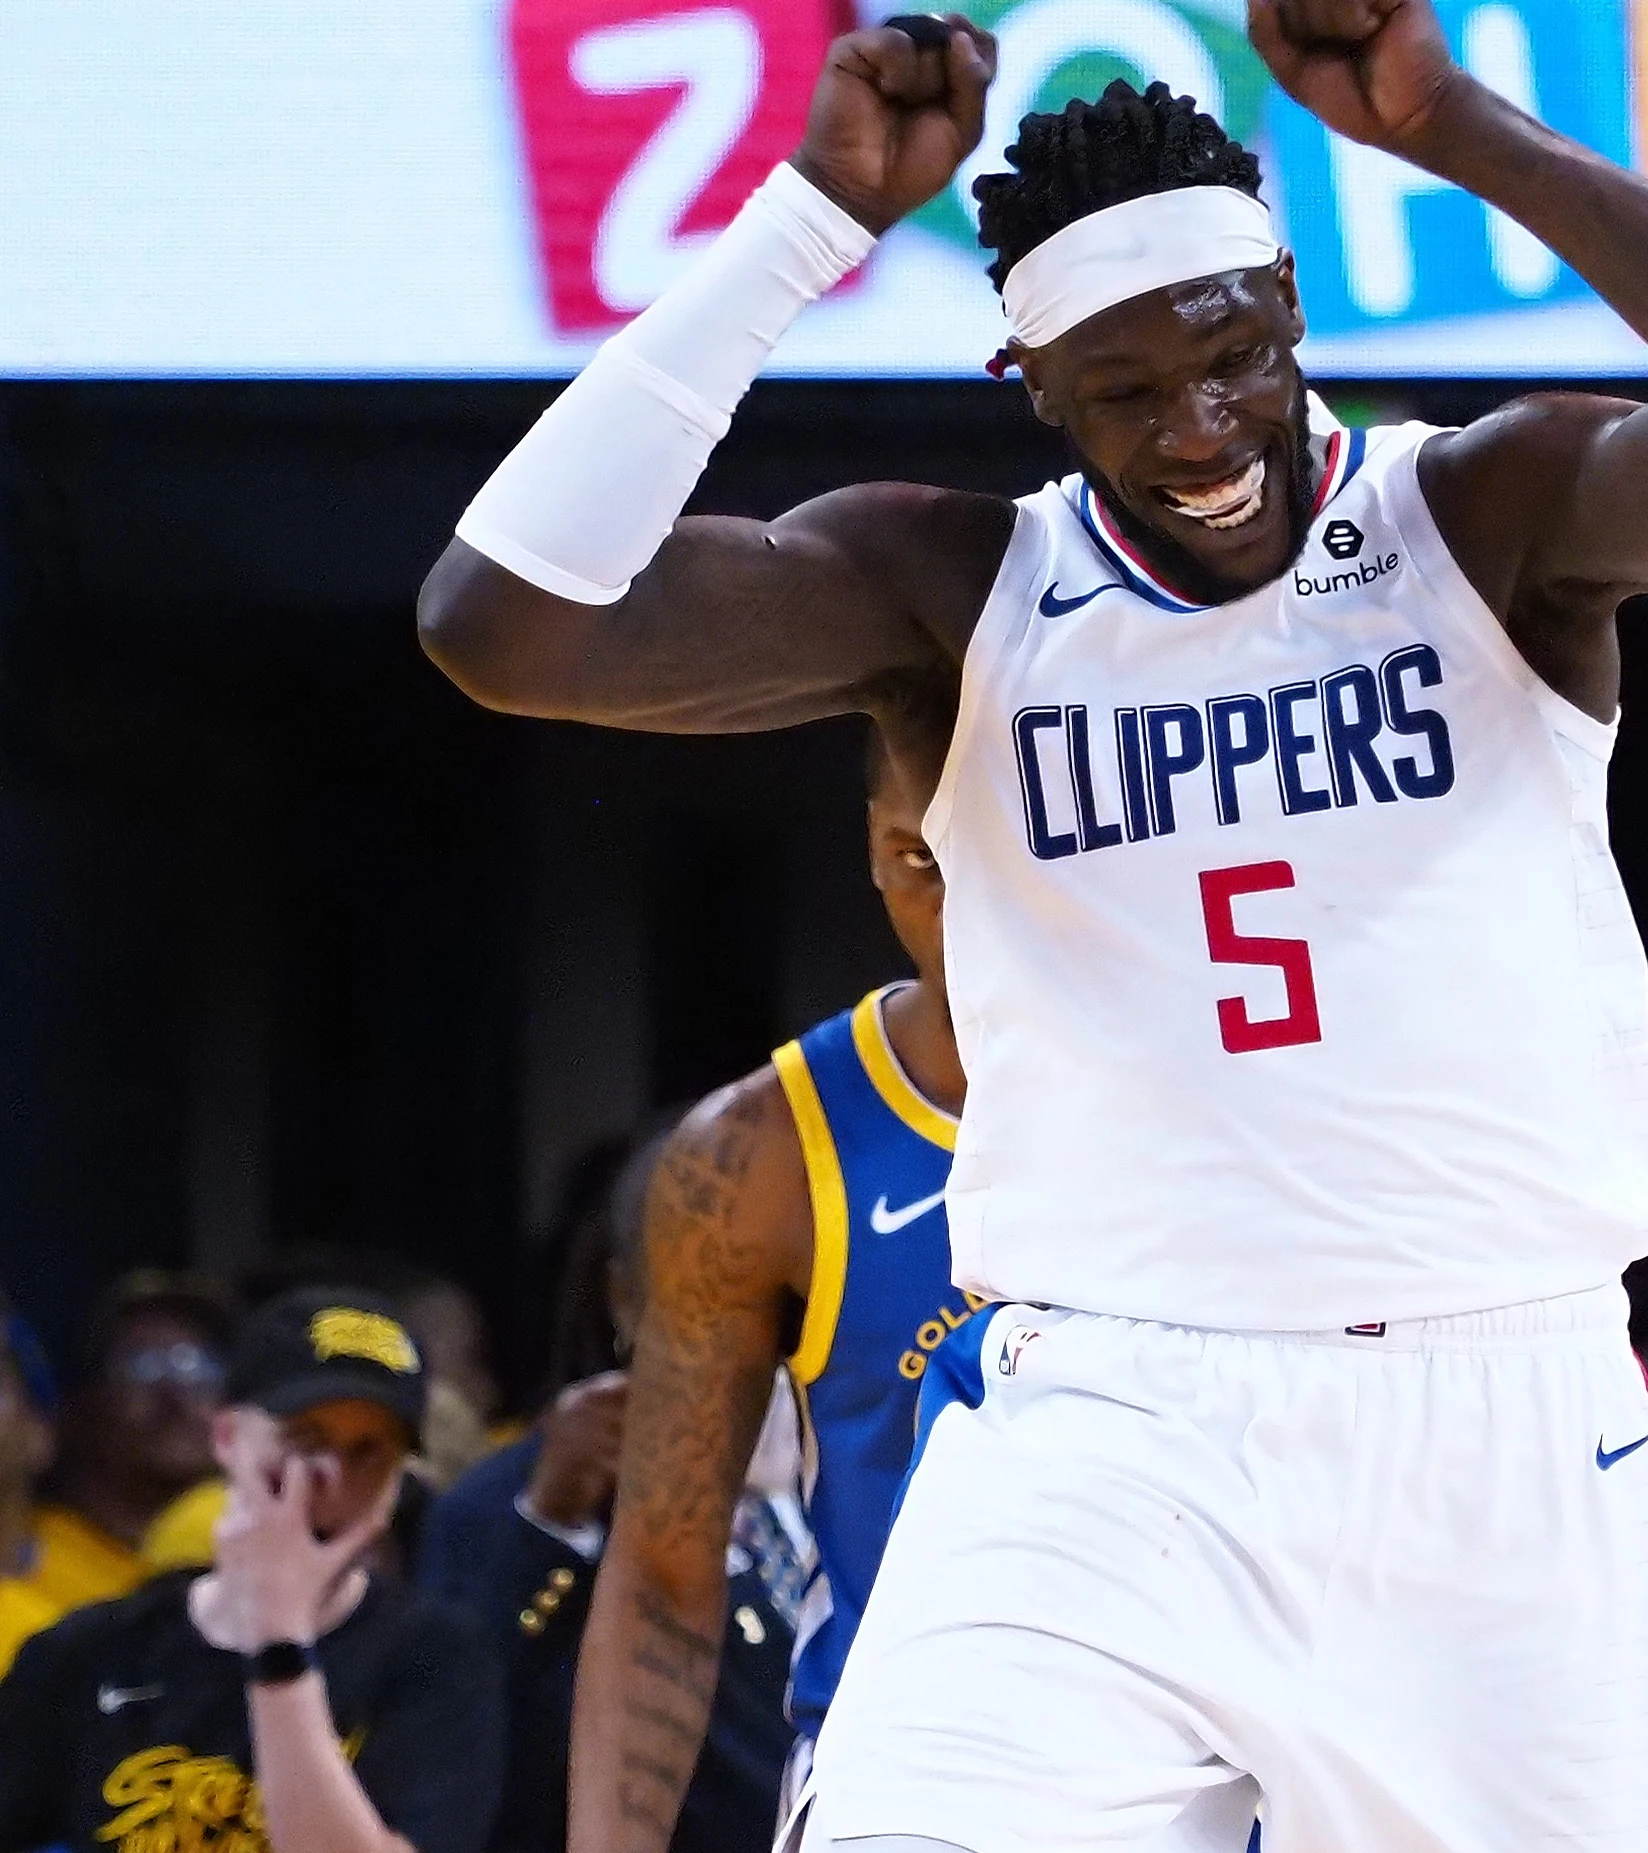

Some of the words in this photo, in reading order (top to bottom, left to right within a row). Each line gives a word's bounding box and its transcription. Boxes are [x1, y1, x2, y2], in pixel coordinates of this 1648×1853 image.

[1294, 552, 1399, 596] bumble
[1012, 643, 1455, 860] CLIPPERS
[1198, 860, 1322, 1054] 5
